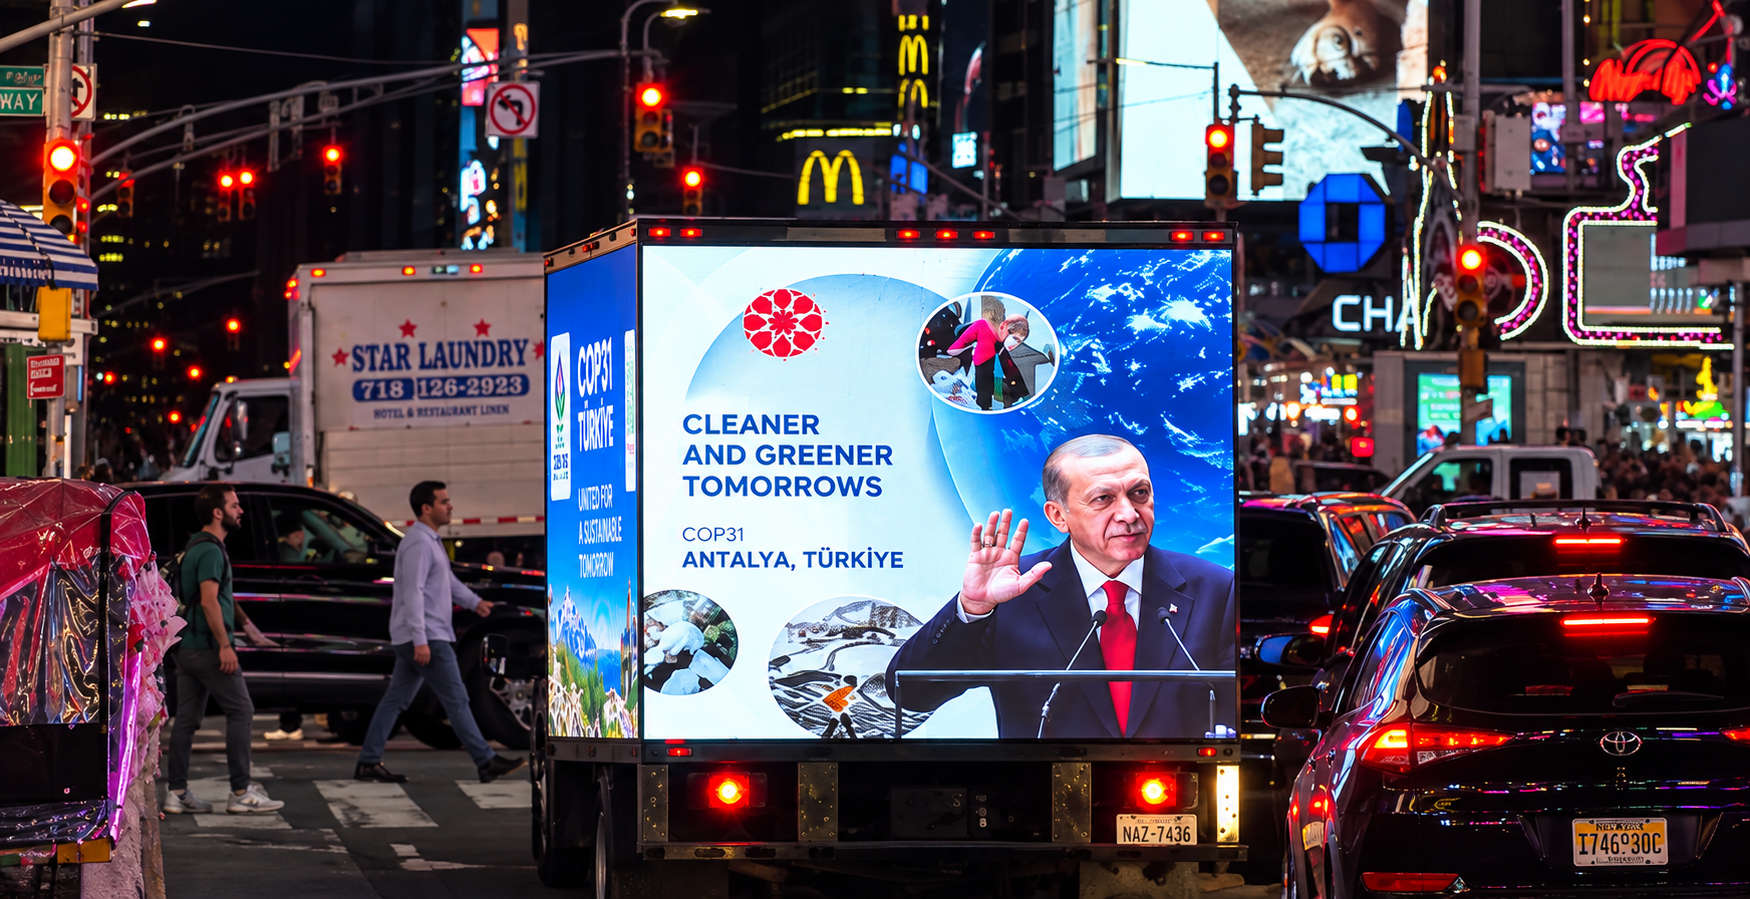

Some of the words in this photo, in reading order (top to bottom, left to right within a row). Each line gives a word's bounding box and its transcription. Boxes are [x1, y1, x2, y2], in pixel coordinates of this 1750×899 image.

[0, 93, 38, 110] WAY
[352, 343, 412, 373] STAR
[418, 338, 529, 370] LAUNDRY
[577, 336, 613, 398] COP31
[361, 380, 404, 399] 718
[418, 376, 522, 397] 126-2923
[373, 408, 404, 419] HOTEL
[407, 408, 414, 418] &
[417, 405, 477, 418] RESTAURANT
[480, 404, 509, 415] LINEN
[577, 397, 614, 452] TÜRKİYE
[682, 413, 820, 435] CLEANER
[682, 444, 746, 466] AND
[755, 444, 893, 466] GREENER
[578, 486, 600, 512] UNITED
[600, 483, 613, 509] FOR
[682, 475, 883, 497] TOMORROWS
[578, 520, 584, 545] A
[682, 526, 744, 542] COP31
[578, 551, 614, 579] TOMORROW
[682, 551, 796, 571] ANTALYA,
[802, 546, 904, 569] TÜRKİYE
[1123, 826, 1191, 843] NAZ-7436
